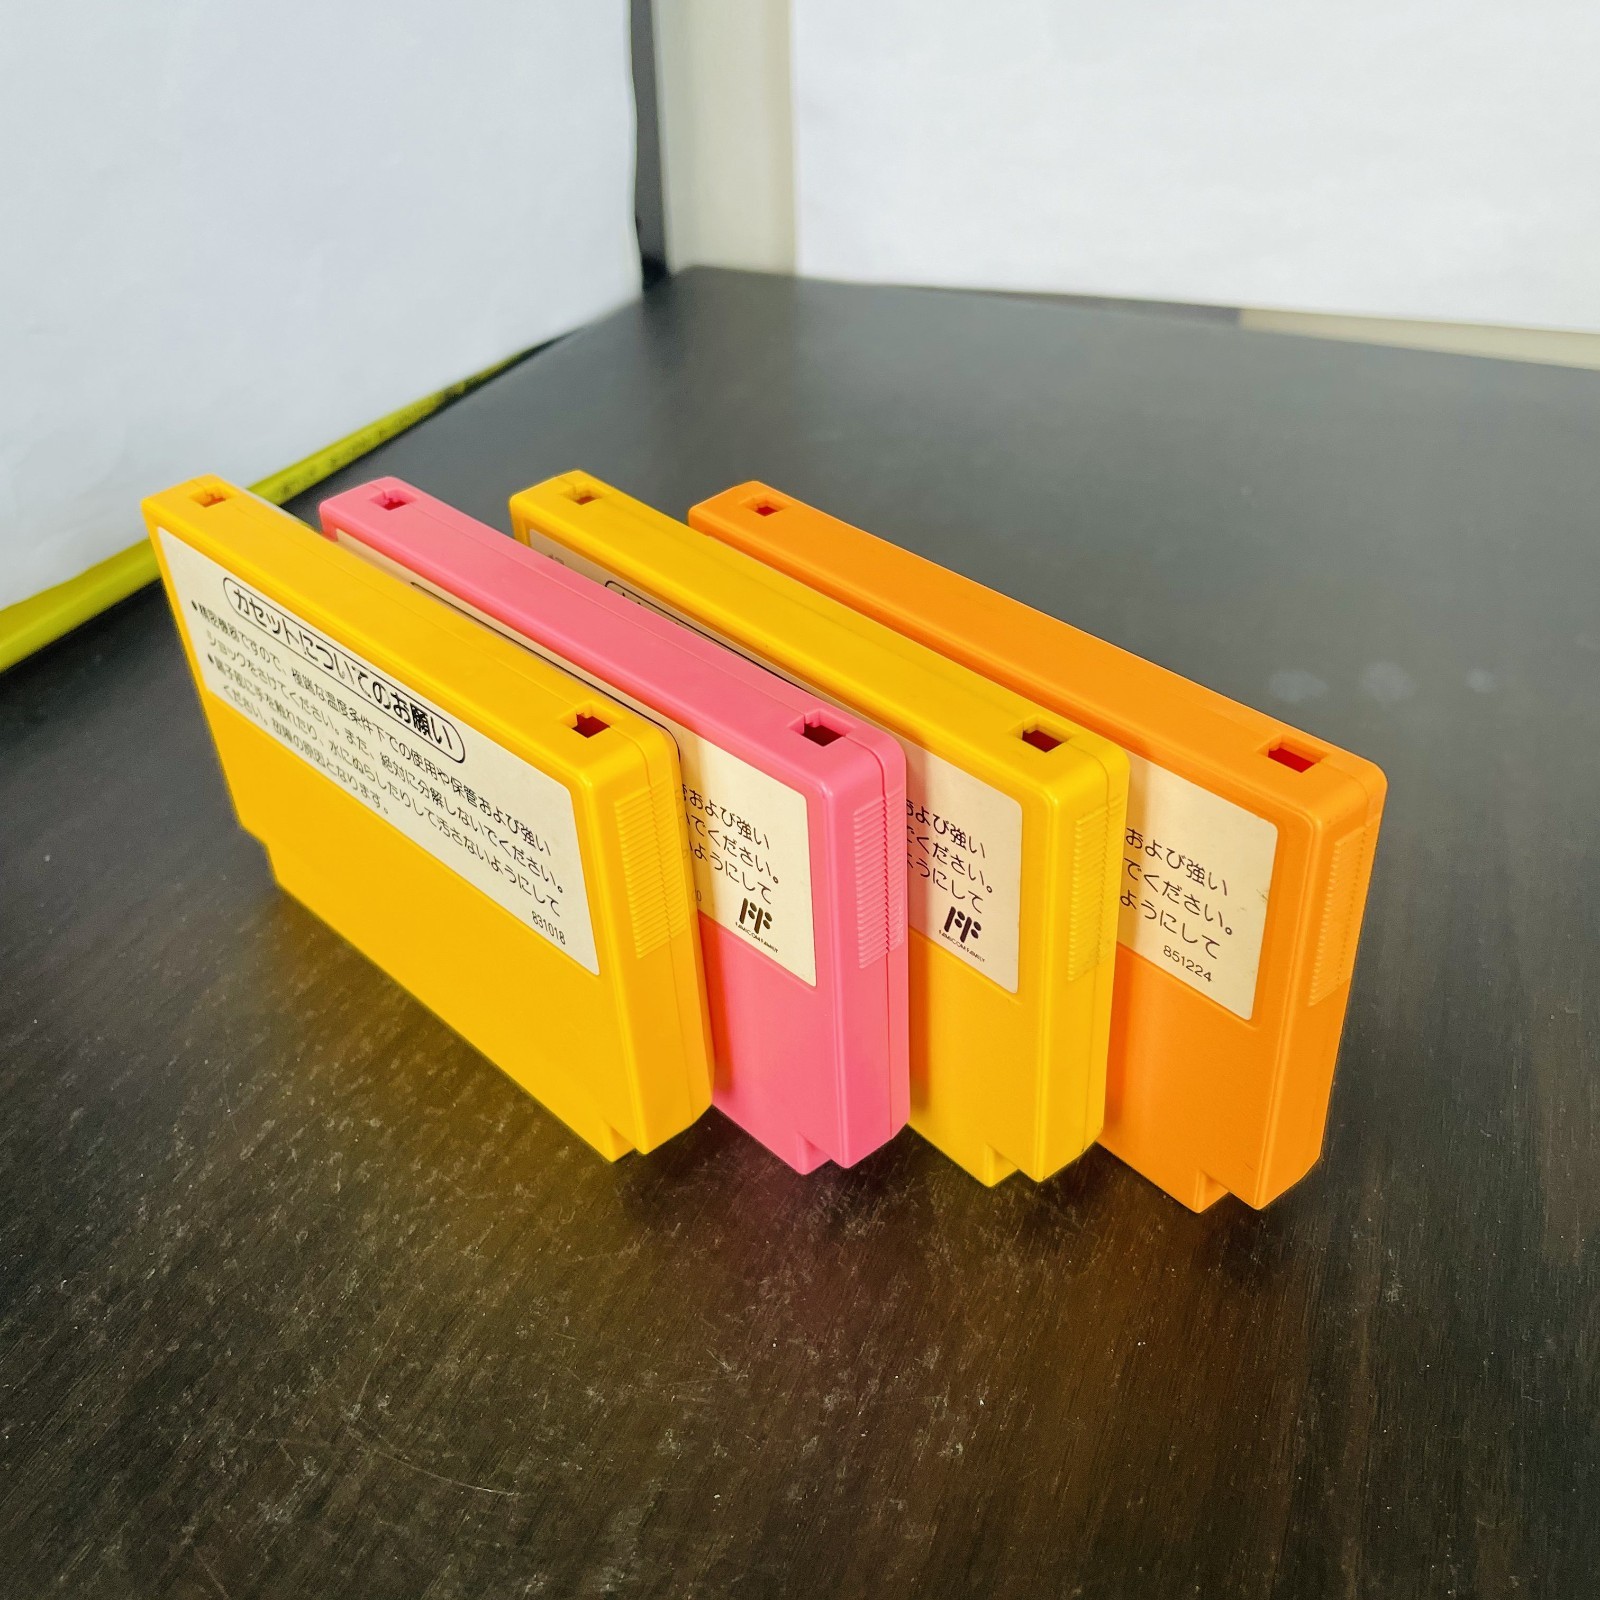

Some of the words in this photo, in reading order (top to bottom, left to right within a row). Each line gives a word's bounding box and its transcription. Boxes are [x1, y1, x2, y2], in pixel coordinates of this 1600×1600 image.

[234, 588, 453, 750] カセットについてのお願い
[689, 839, 772, 905] ようにして
[1125, 827, 1228, 896] および強い
[531, 910, 566, 945] 831018
[1120, 889, 1221, 960] ようにして
[1123, 857, 1233, 936] でください。
[1163, 945, 1213, 983] 851224
